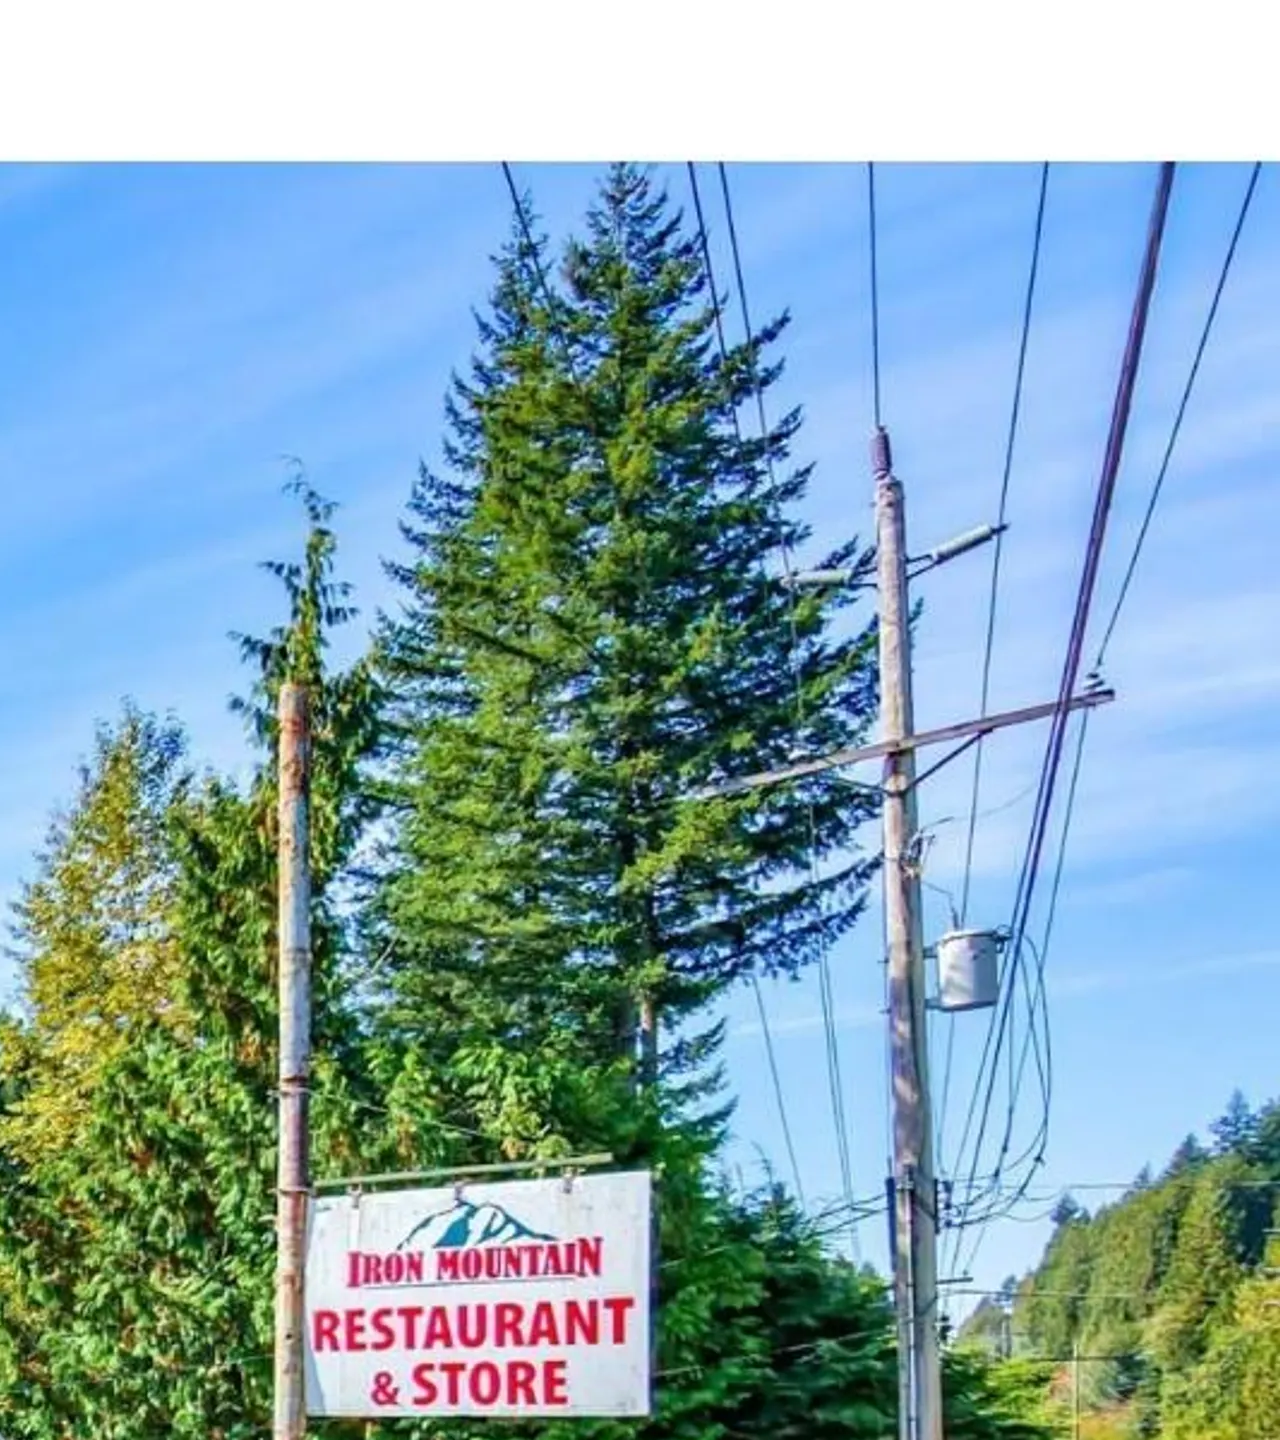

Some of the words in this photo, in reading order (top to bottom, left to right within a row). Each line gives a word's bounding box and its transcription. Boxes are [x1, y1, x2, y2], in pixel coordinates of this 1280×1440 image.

[347, 1251, 424, 1288] IRON
[436, 1237, 603, 1281] MOUNTAIN
[312, 1297, 634, 1352] RESTAURANT
[370, 1371, 400, 1405] &
[412, 1361, 568, 1406] STORE
